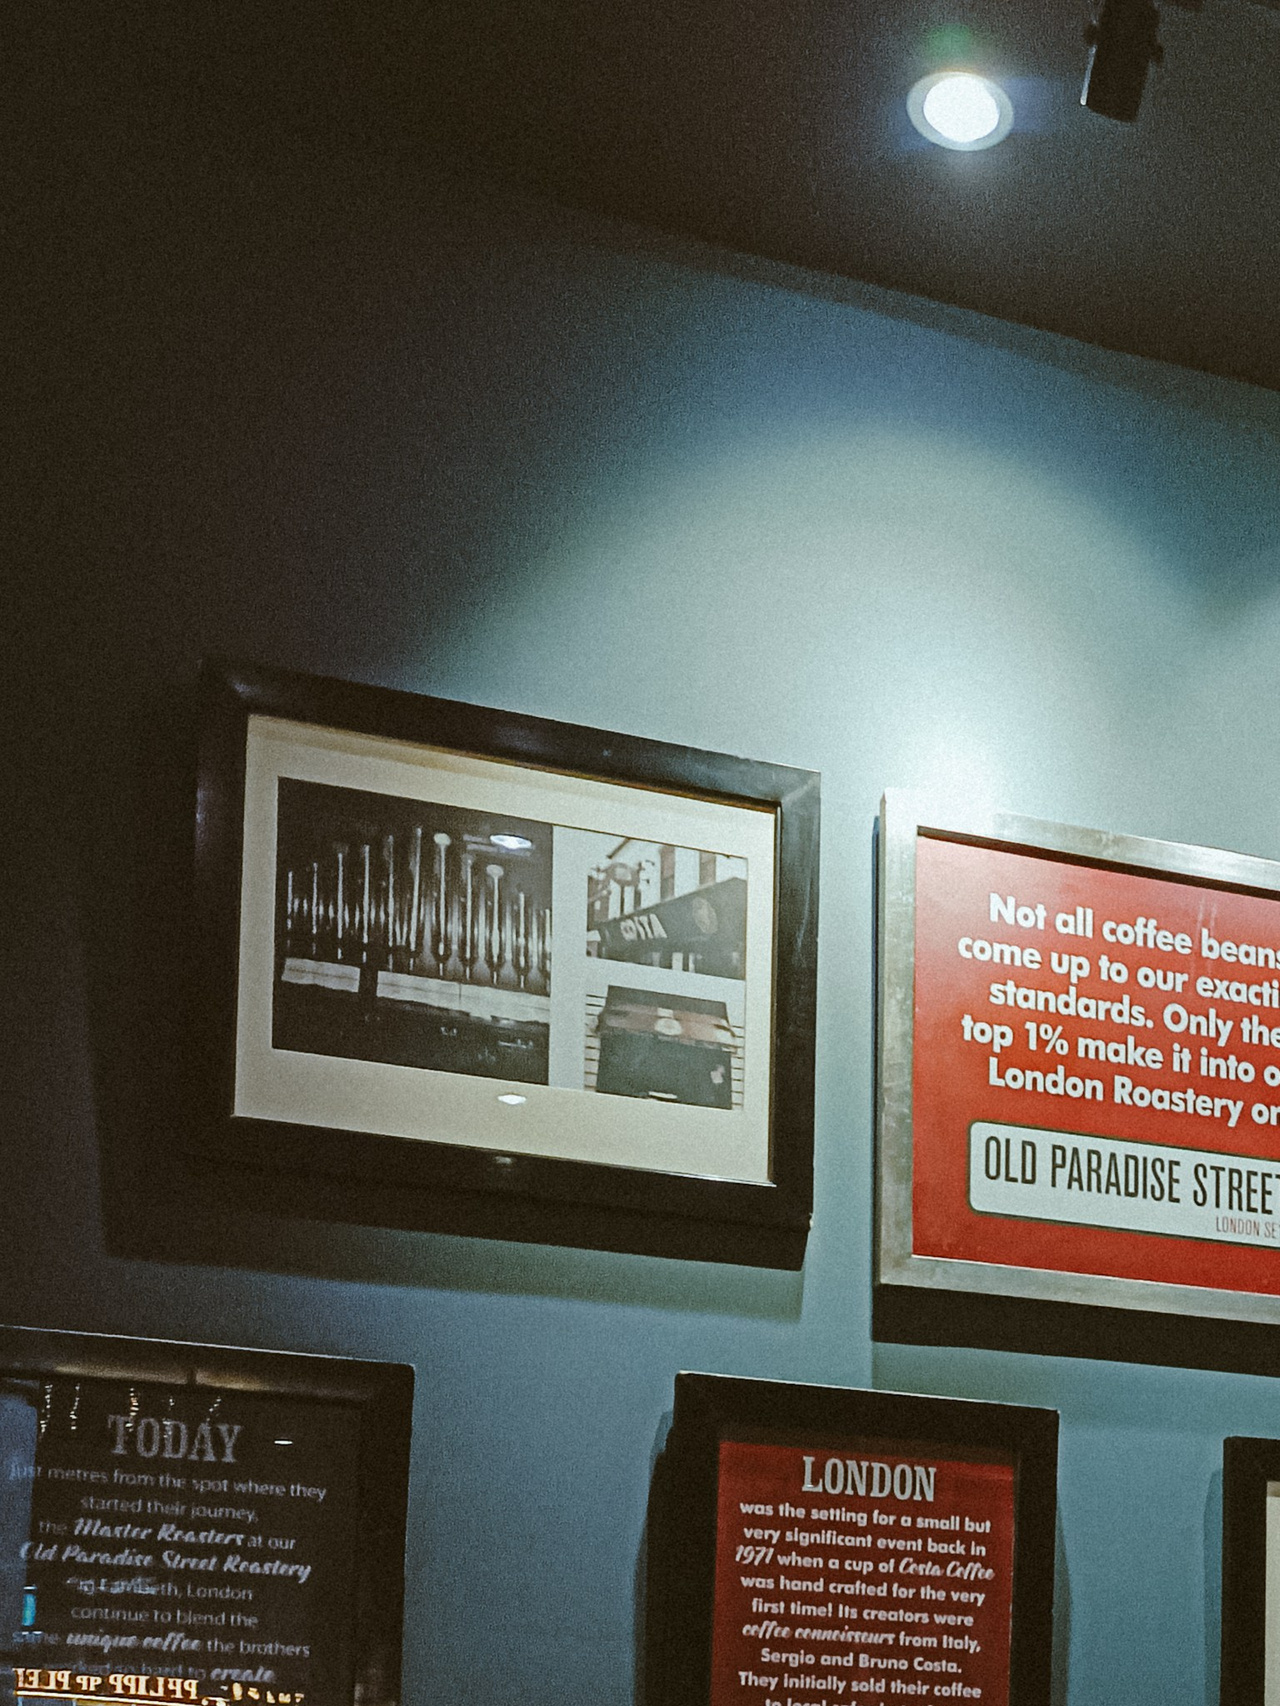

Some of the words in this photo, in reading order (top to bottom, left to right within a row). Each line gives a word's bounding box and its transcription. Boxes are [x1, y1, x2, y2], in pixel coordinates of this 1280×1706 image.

[989, 892, 1047, 930] Not
[1055, 906, 1093, 939] all
[1102, 916, 1193, 955] coffee
[957, 936, 1042, 970] come
[1051, 951, 1091, 984] up
[1098, 954, 1129, 984] to
[1137, 966, 1189, 993] our
[989, 979, 1154, 1029] standards.
[1163, 1002, 1234, 1047] Only
[961, 1013, 1014, 1054] top
[1024, 1021, 1070, 1056] 1%
[1077, 1034, 1164, 1070] make
[1172, 1042, 1192, 1074] it
[1200, 1046, 1256, 1083] into
[988, 1056, 1104, 1101] London
[1113, 1074, 1244, 1128] Roastery
[984, 1135, 1037, 1185] OLD
[1051, 1143, 1181, 1204] PARADISE
[1216, 1216, 1260, 1237] LONDON
[106, 1413, 243, 1464] TODAY
[47, 1466, 109, 1483] metres
[113, 1468, 155, 1486] from
[158, 1472, 187, 1488] the
[191, 1478, 229, 1494] spot
[233, 1478, 286, 1497] where
[289, 1482, 327, 1503] they
[802, 1456, 936, 1502] LONDON
[80, 1496, 143, 1513] started
[146, 1500, 187, 1516] their
[739, 1502, 774, 1516] was
[778, 1502, 806, 1519] the
[810, 1506, 868, 1527] setting
[872, 1509, 897, 1526] for
[901, 1515, 912, 1527] a
[916, 1515, 960, 1531] small
[964, 1516, 991, 1533] but
[73, 1516, 153, 1541] Master
[156, 1522, 245, 1547] Roasters
[247, 1534, 263, 1549] at
[267, 1538, 296, 1550] our
[743, 1527, 781, 1544] very
[785, 1526, 873, 1547] significant
[876, 1537, 923, 1552] event
[927, 1537, 966, 1555] back
[970, 1541, 986, 1557] in
[61, 1543, 154, 1568] Paradise
[161, 1549, 218, 1572] Street
[222, 1553, 312, 1585] Roastery
[735, 1544, 775, 1566] 1971
[777, 1550, 824, 1569] when
[828, 1558, 839, 1570] a
[844, 1559, 874, 1575] cup
[878, 1558, 895, 1573] of
[898, 1557, 944, 1577] Costa
[946, 1560, 996, 1581] Coffee
[186, 1581, 254, 1601] London
[740, 1576, 775, 1590] was
[779, 1574, 824, 1592] hand
[828, 1580, 888, 1597] crafted
[892, 1582, 917, 1599] for
[920, 1584, 946, 1601] the
[950, 1590, 986, 1607] very
[71, 1606, 150, 1622] continue
[153, 1608, 172, 1624] to
[176, 1608, 226, 1626] blend
[229, 1612, 259, 1628] the
[751, 1597, 785, 1614] first
[789, 1600, 833, 1618] time!
[838, 1603, 858, 1620] Its
[862, 1608, 930, 1624] creators
[933, 1613, 975, 1627] were
[65, 1627, 138, 1654] unique
[142, 1631, 201, 1653] coffee
[206, 1636, 236, 1653] the
[239, 1638, 311, 1658] brothers
[742, 1620, 792, 1640] coffee
[794, 1624, 896, 1645] connoisseurs
[899, 1631, 938, 1648] from
[942, 1634, 982, 1654] Italy,
[760, 1647, 816, 1668] Sergio
[820, 1652, 854, 1667] and
[858, 1653, 909, 1671] Bruno
[913, 1656, 963, 1674] Costa.
[738, 1670, 779, 1691] They
[783, 1673, 847, 1695] initially
[850, 1677, 886, 1693] sold
[890, 1679, 930, 1696] their
[933, 1681, 983, 1699] coffee
